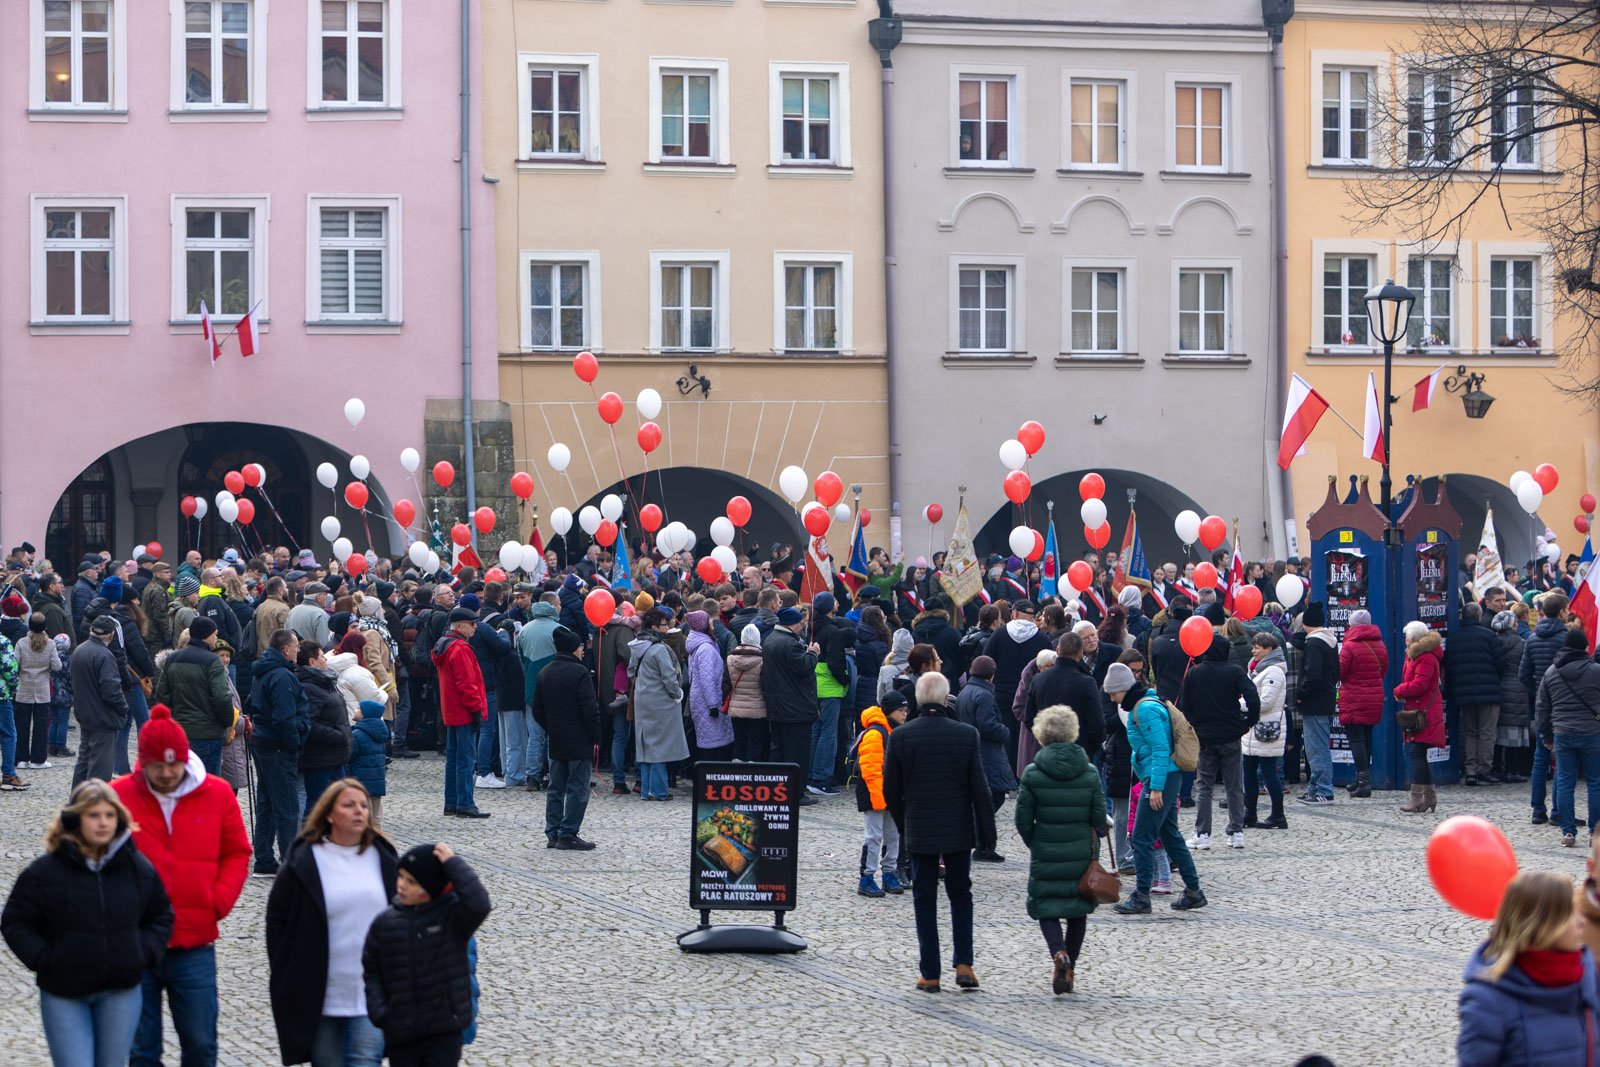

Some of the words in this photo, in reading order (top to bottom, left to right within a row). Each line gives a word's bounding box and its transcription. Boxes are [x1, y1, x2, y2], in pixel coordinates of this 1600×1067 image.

[1330, 571, 1357, 584] JELENIA
[1420, 568, 1441, 581] JELENIA
[1420, 604, 1446, 617] DEZERTER
[706, 774, 752, 782] NIESAMOWICIE
[705, 782, 788, 802] ŁOSOŚ
[763, 813, 789, 821] ŻYWYM
[700, 891, 722, 900] PLAC
[724, 892, 773, 901] RATUSZOWY
[775, 893, 786, 901] 39
